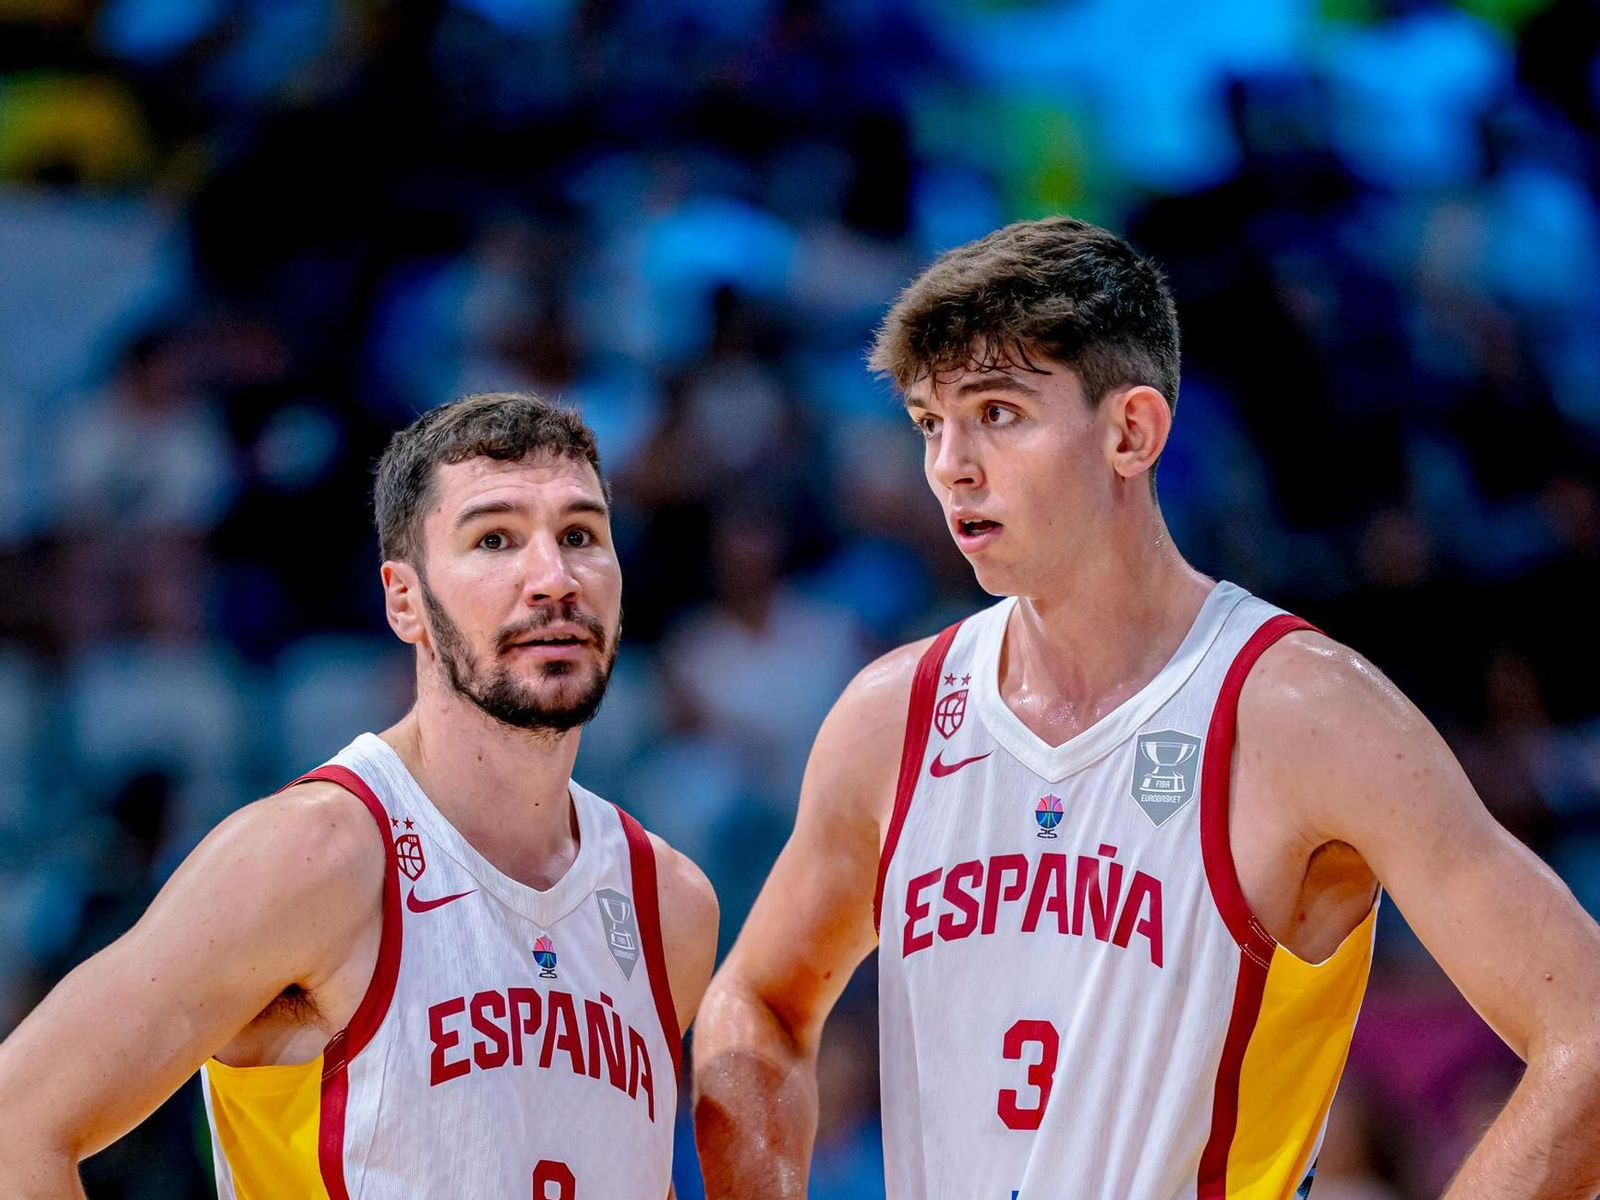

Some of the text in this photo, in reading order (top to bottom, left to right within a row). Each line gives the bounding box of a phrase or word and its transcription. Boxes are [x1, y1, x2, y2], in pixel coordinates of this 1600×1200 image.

[1140, 794, 1182, 804] EUROBASKET
[1155, 780, 1171, 789] FIBA
[902, 843, 1164, 969] ESPAÑA
[428, 987, 655, 1124] ESPAÑA
[997, 1019, 1060, 1131] 3
